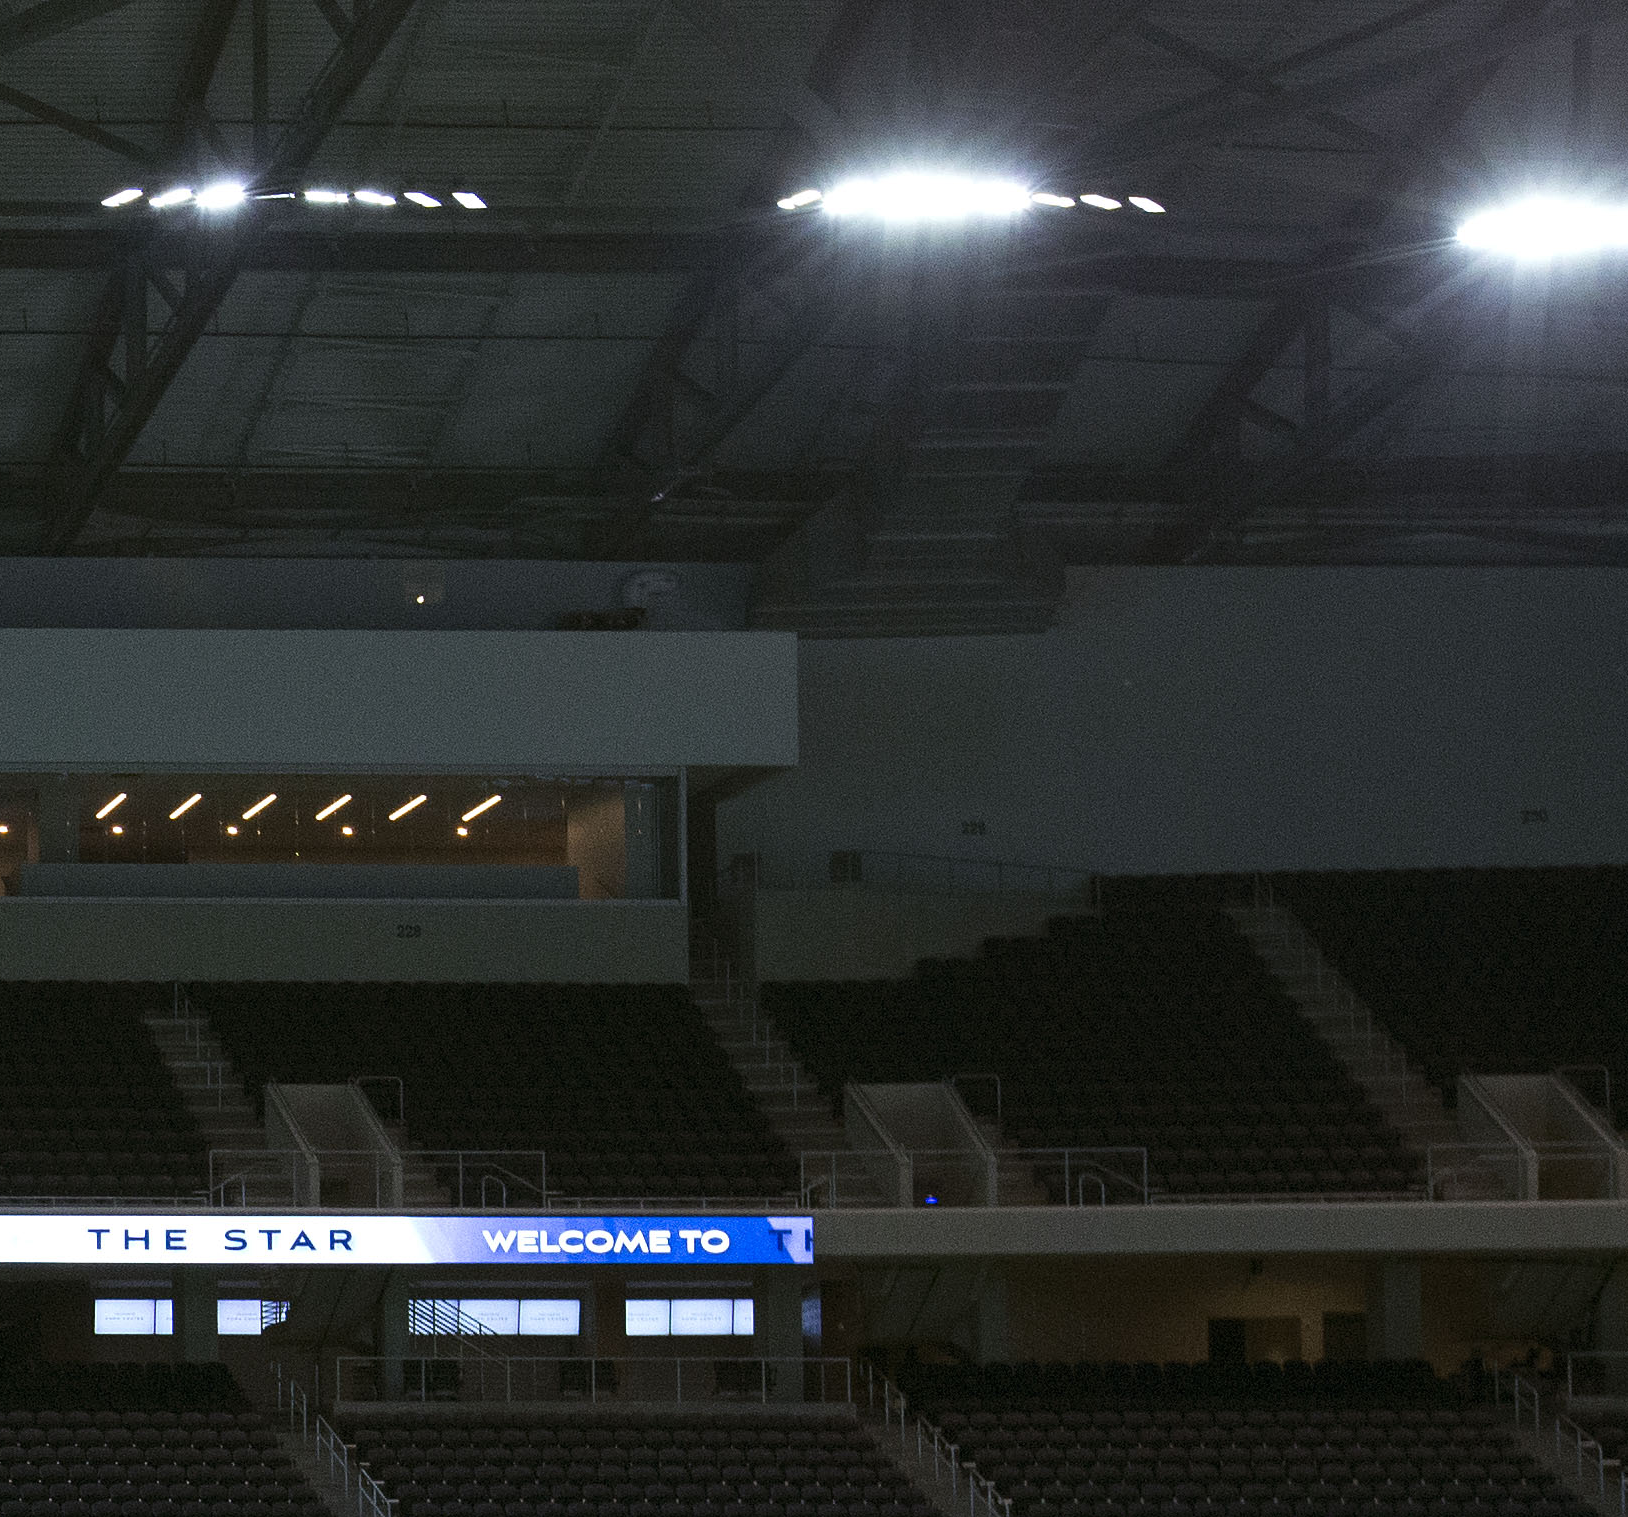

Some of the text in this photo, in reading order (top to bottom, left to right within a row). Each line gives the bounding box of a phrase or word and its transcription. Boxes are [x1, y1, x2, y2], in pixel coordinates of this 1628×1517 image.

[87, 1228, 354, 1251] THE STAR
[482, 1229, 730, 1253] WELCOME TO
